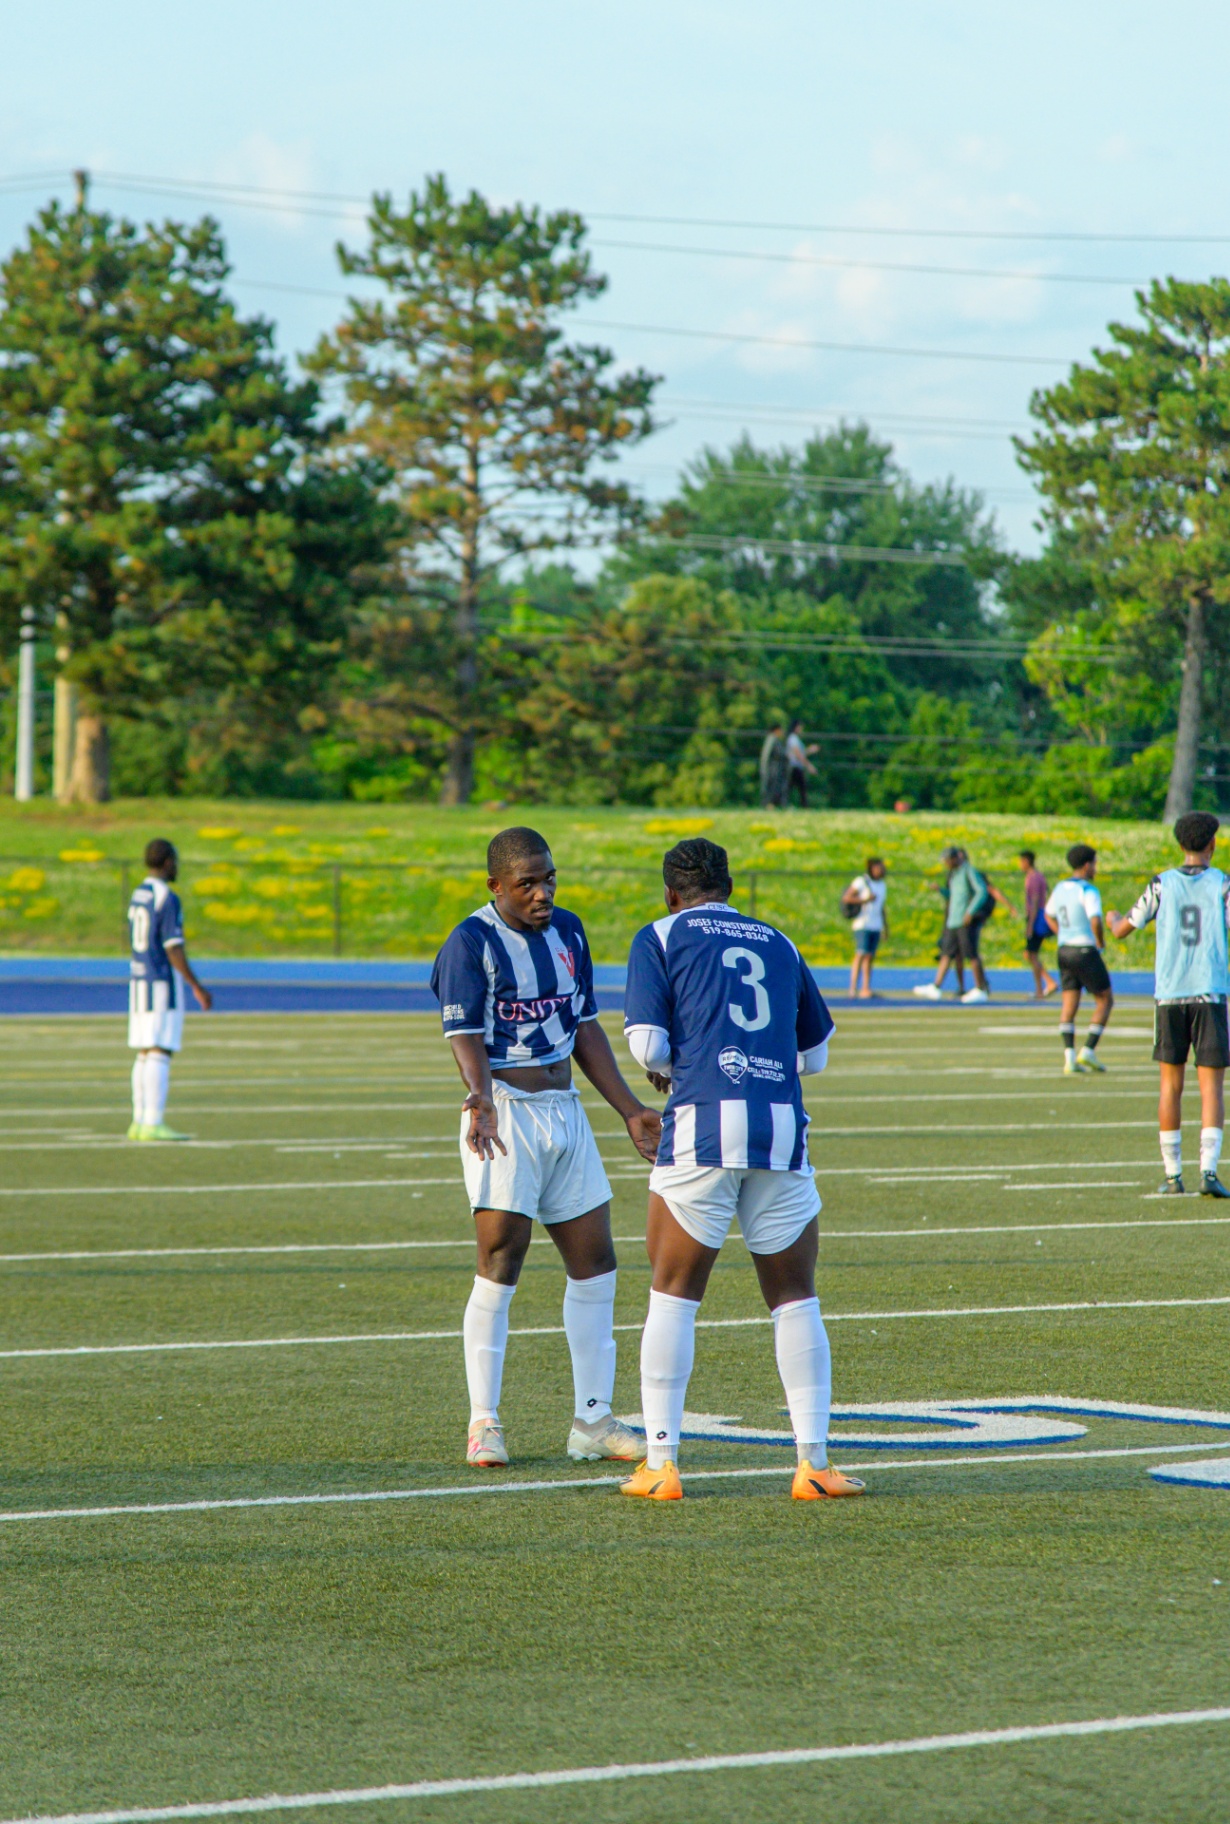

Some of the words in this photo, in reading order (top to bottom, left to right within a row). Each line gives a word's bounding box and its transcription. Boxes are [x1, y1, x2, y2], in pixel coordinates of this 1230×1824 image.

[687, 918, 712, 928] JOSEF
[713, 920, 776, 937] CONSTRUCTION
[1059, 906, 1070, 928] 3
[1180, 905, 1201, 947] 9
[702, 926, 770, 943] 519-865-0348
[722, 946, 771, 1032] 3
